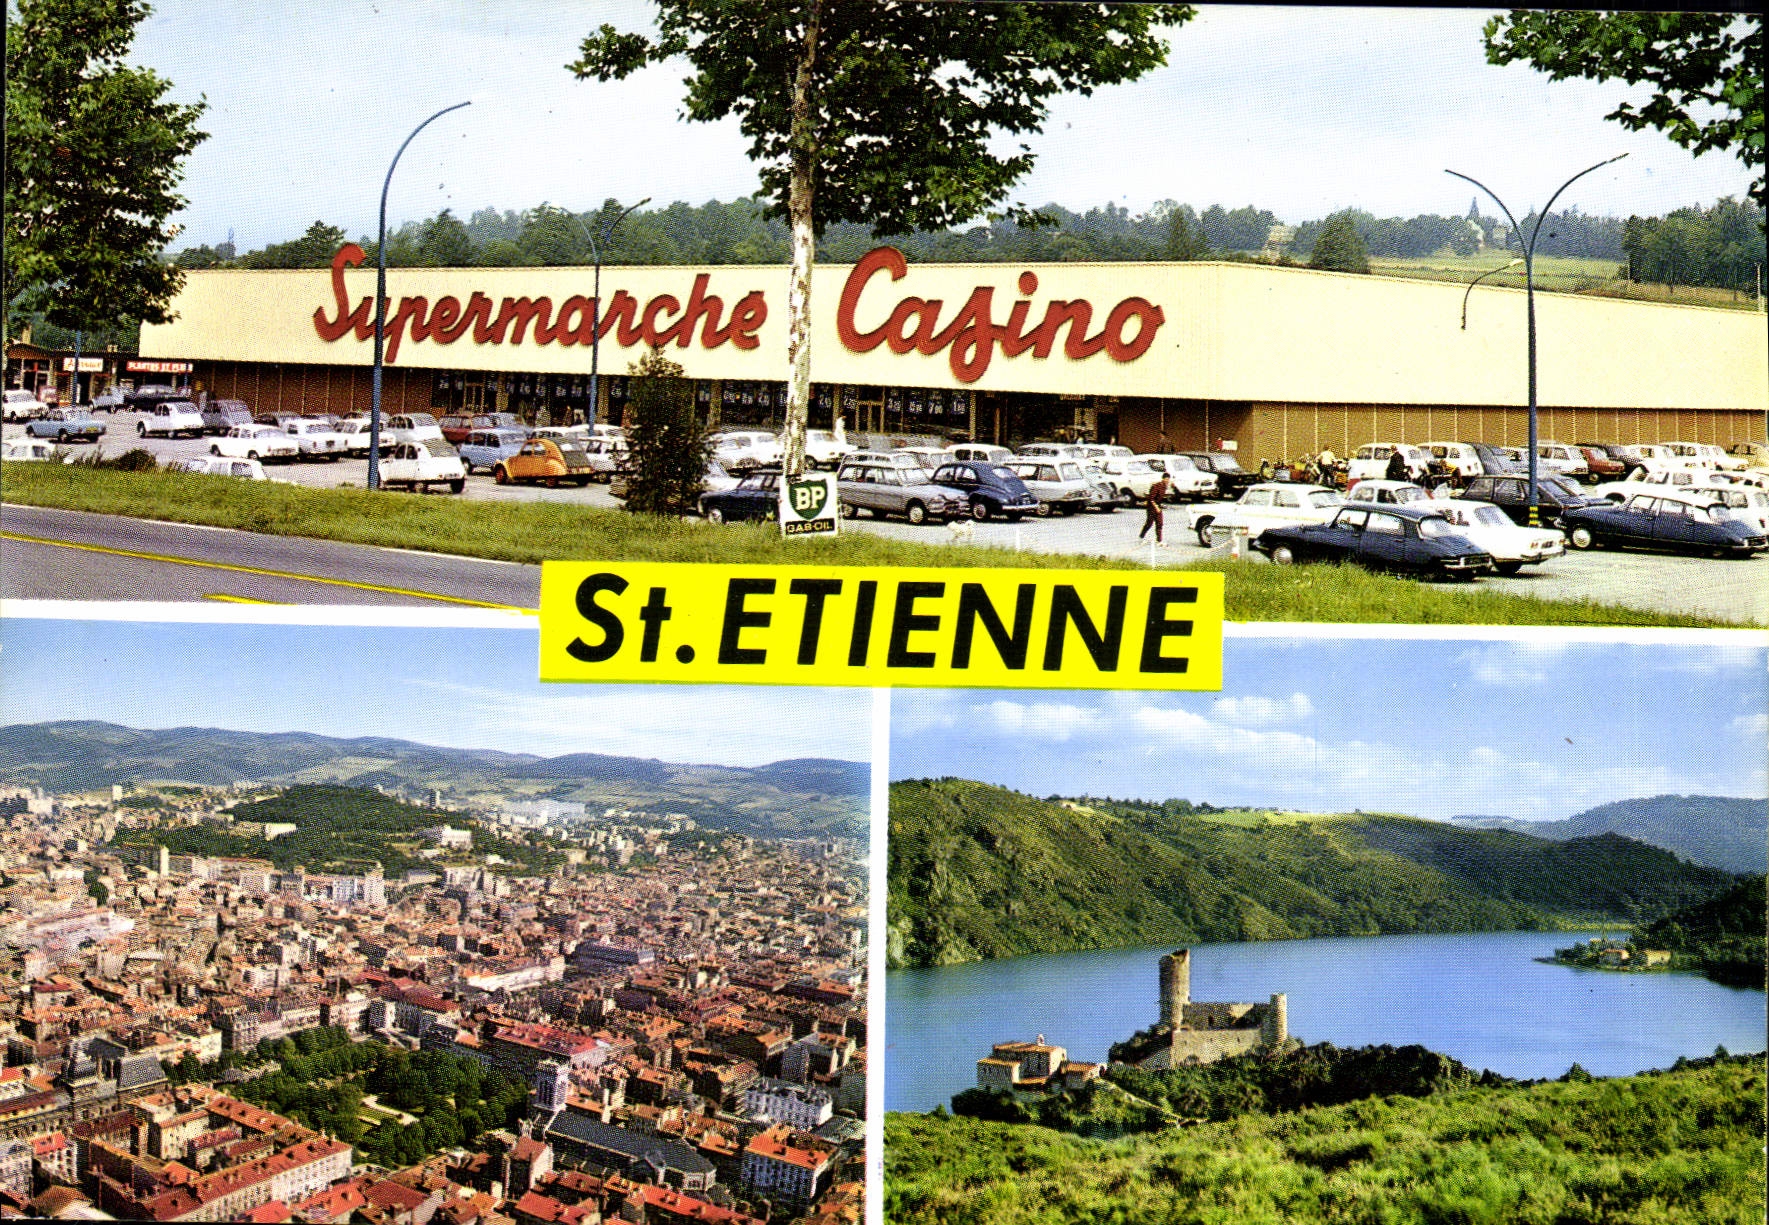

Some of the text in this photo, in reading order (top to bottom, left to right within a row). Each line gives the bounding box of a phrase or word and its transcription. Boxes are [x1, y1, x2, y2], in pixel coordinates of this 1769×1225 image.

[313, 243, 1165, 383] Supermarche Casino
[794, 486, 826, 510] BP
